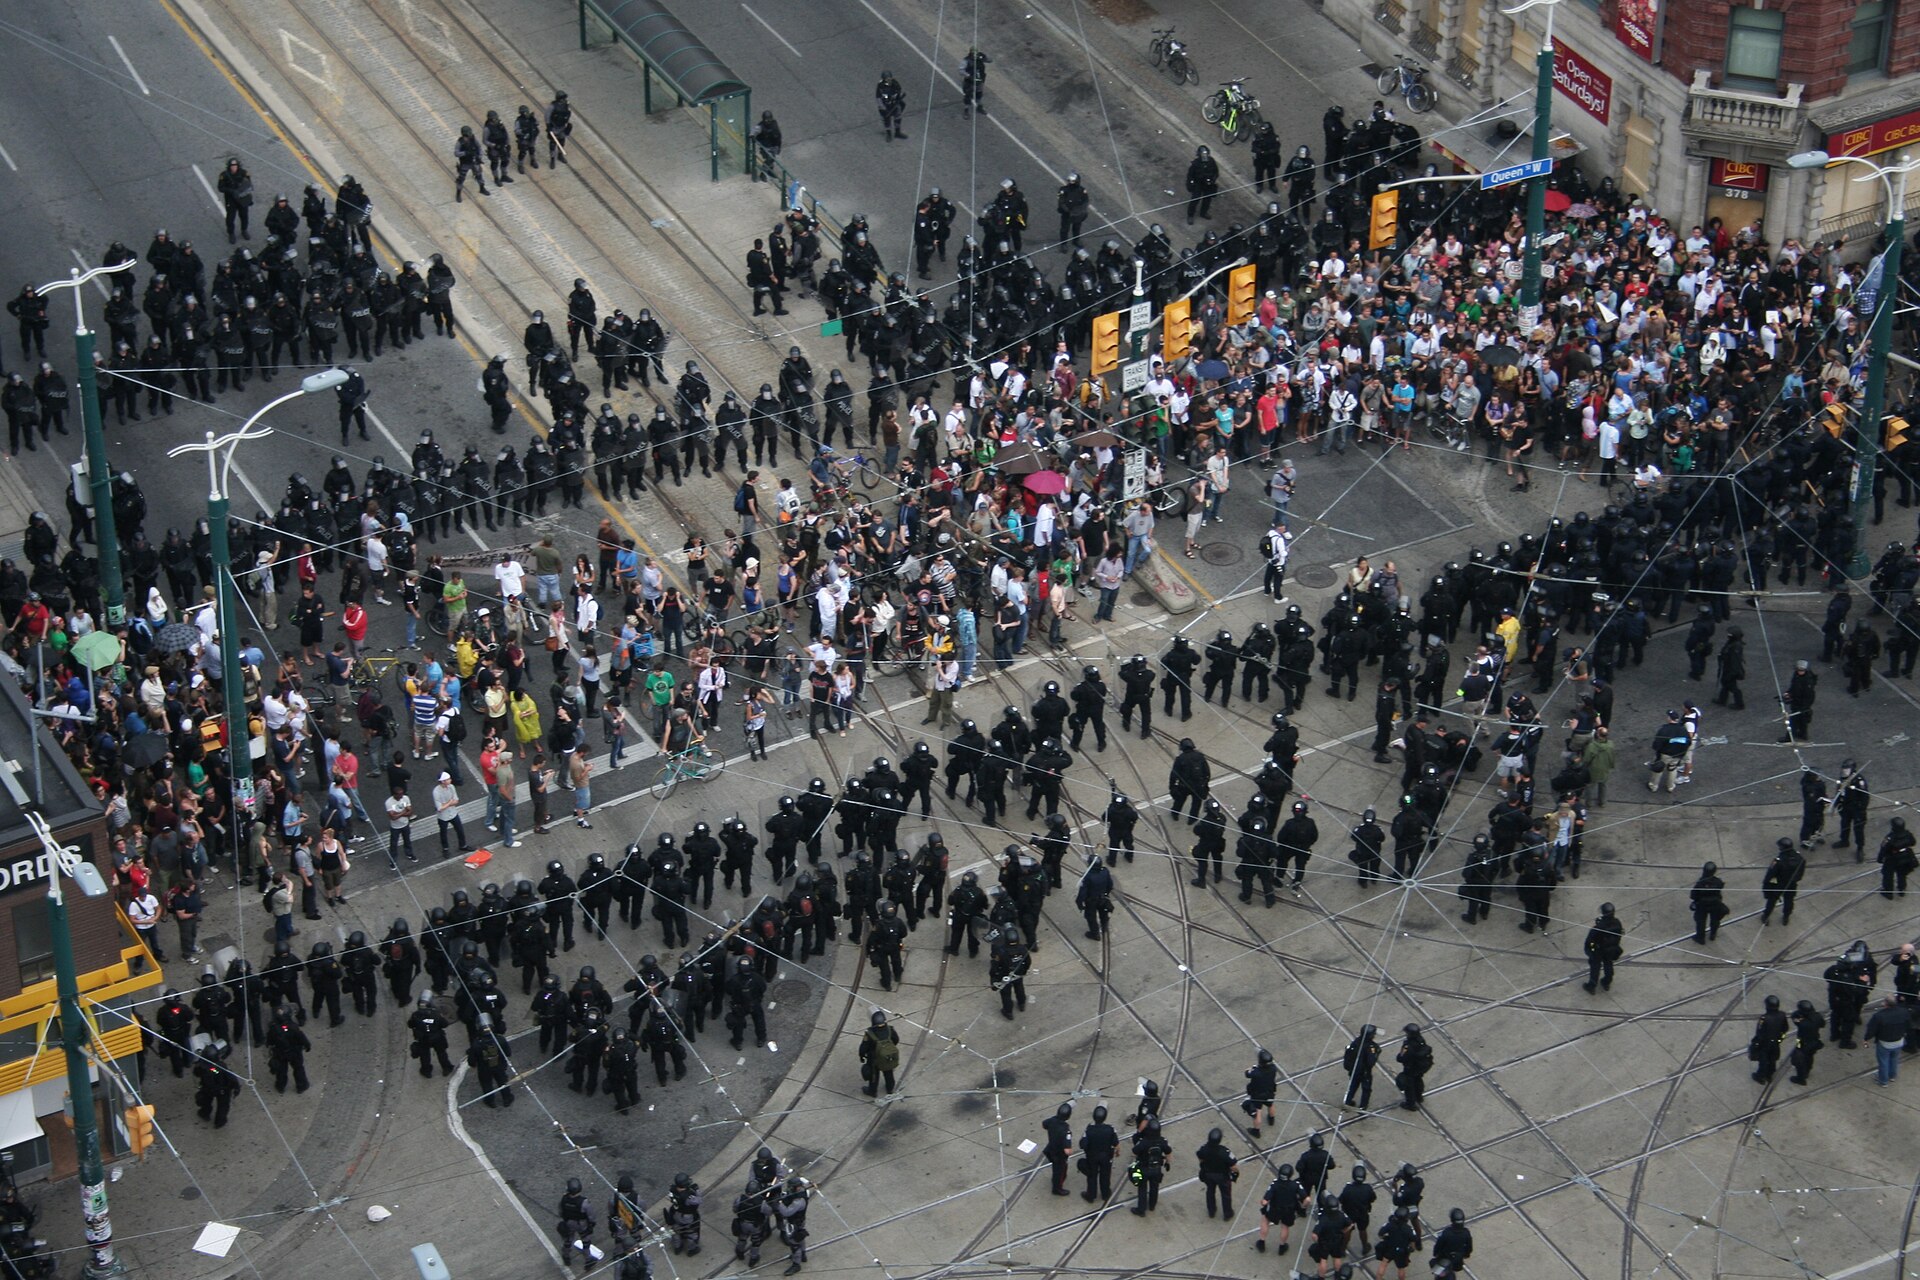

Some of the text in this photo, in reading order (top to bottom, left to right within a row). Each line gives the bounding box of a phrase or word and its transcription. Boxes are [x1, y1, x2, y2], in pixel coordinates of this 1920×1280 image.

[1566, 59, 1592, 87] Open
[1551, 63, 1605, 115] Saturdays!
[1845, 129, 1870, 146] CIBC
[1884, 126, 1908, 142] CIBC
[1490, 168, 1524, 183] Queen
[1532, 161, 1543, 173] W
[1726, 162, 1755, 175] CIBC
[1725, 188, 1749, 200] 378
[351, 307, 371, 318] POLICE
[1133, 305, 1149, 315] LEFT
[1133, 313, 1149, 322] TURN
[314, 321, 337, 329] POLICE
[1132, 321, 1149, 329] SIGNAL
[1125, 360, 1148, 377] TRANSIT
[1125, 376, 1146, 389] SIGNAL
